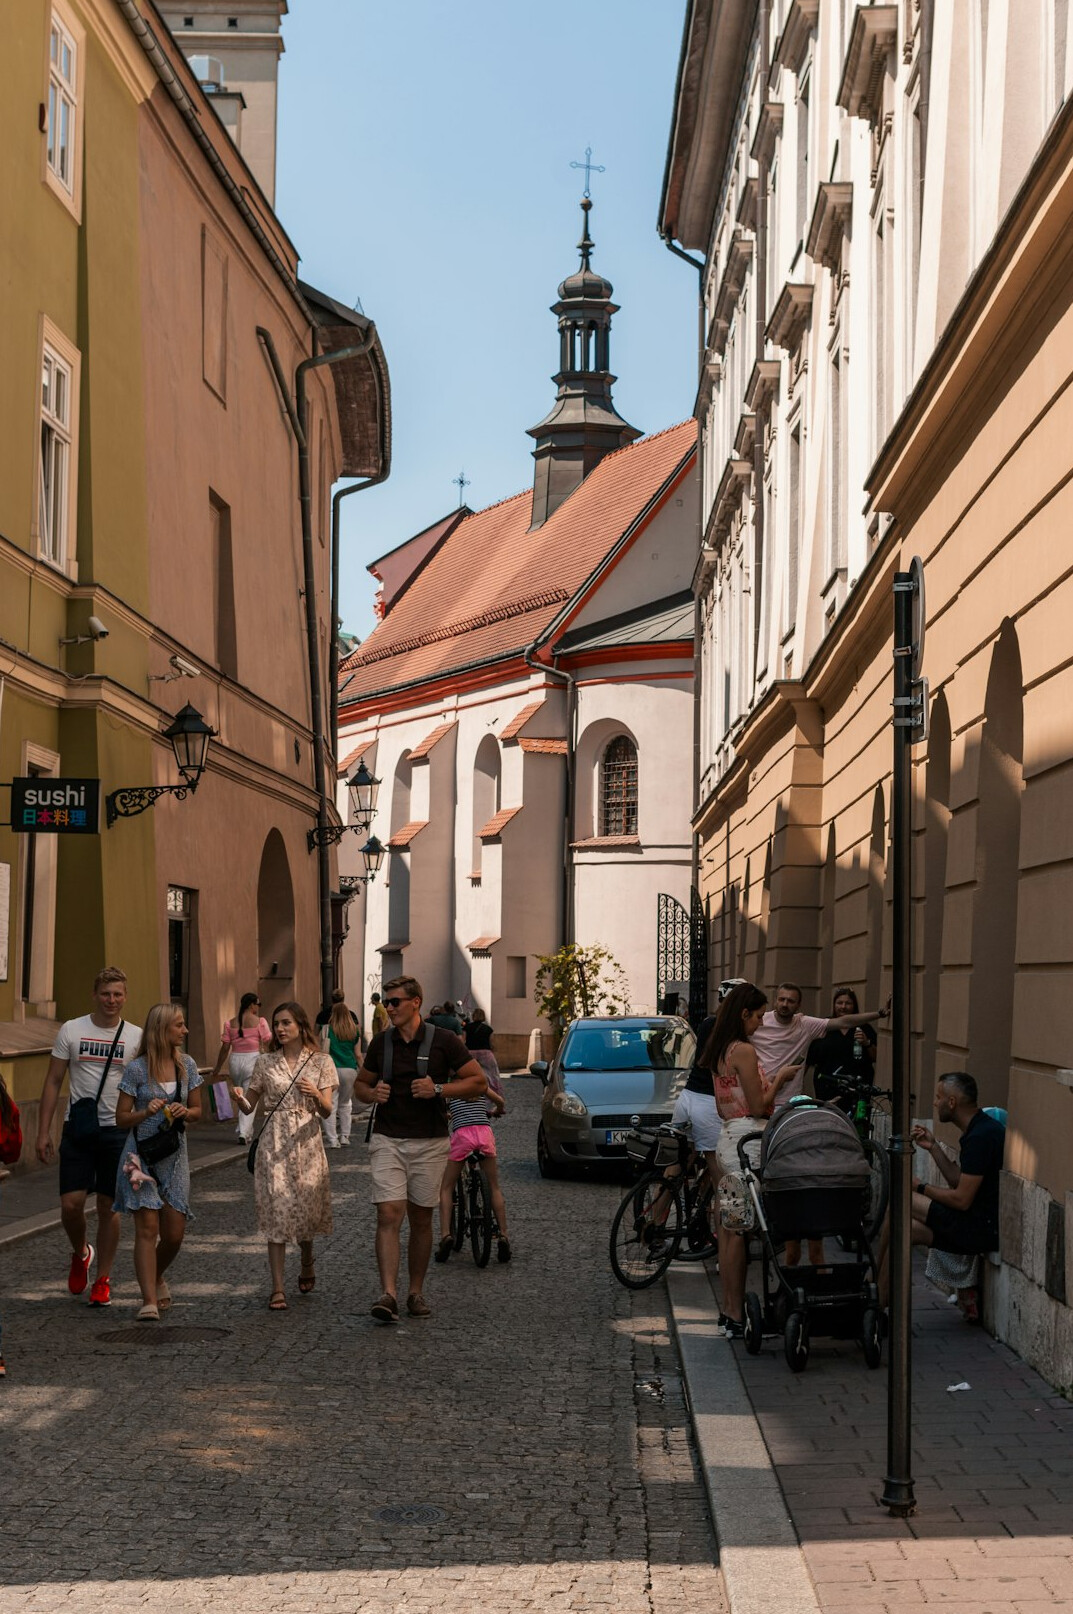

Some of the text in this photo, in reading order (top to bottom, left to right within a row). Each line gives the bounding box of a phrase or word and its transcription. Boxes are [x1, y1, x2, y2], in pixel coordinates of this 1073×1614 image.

[24, 785, 85, 806] sushi
[23, 808, 87, 826] 日本料理
